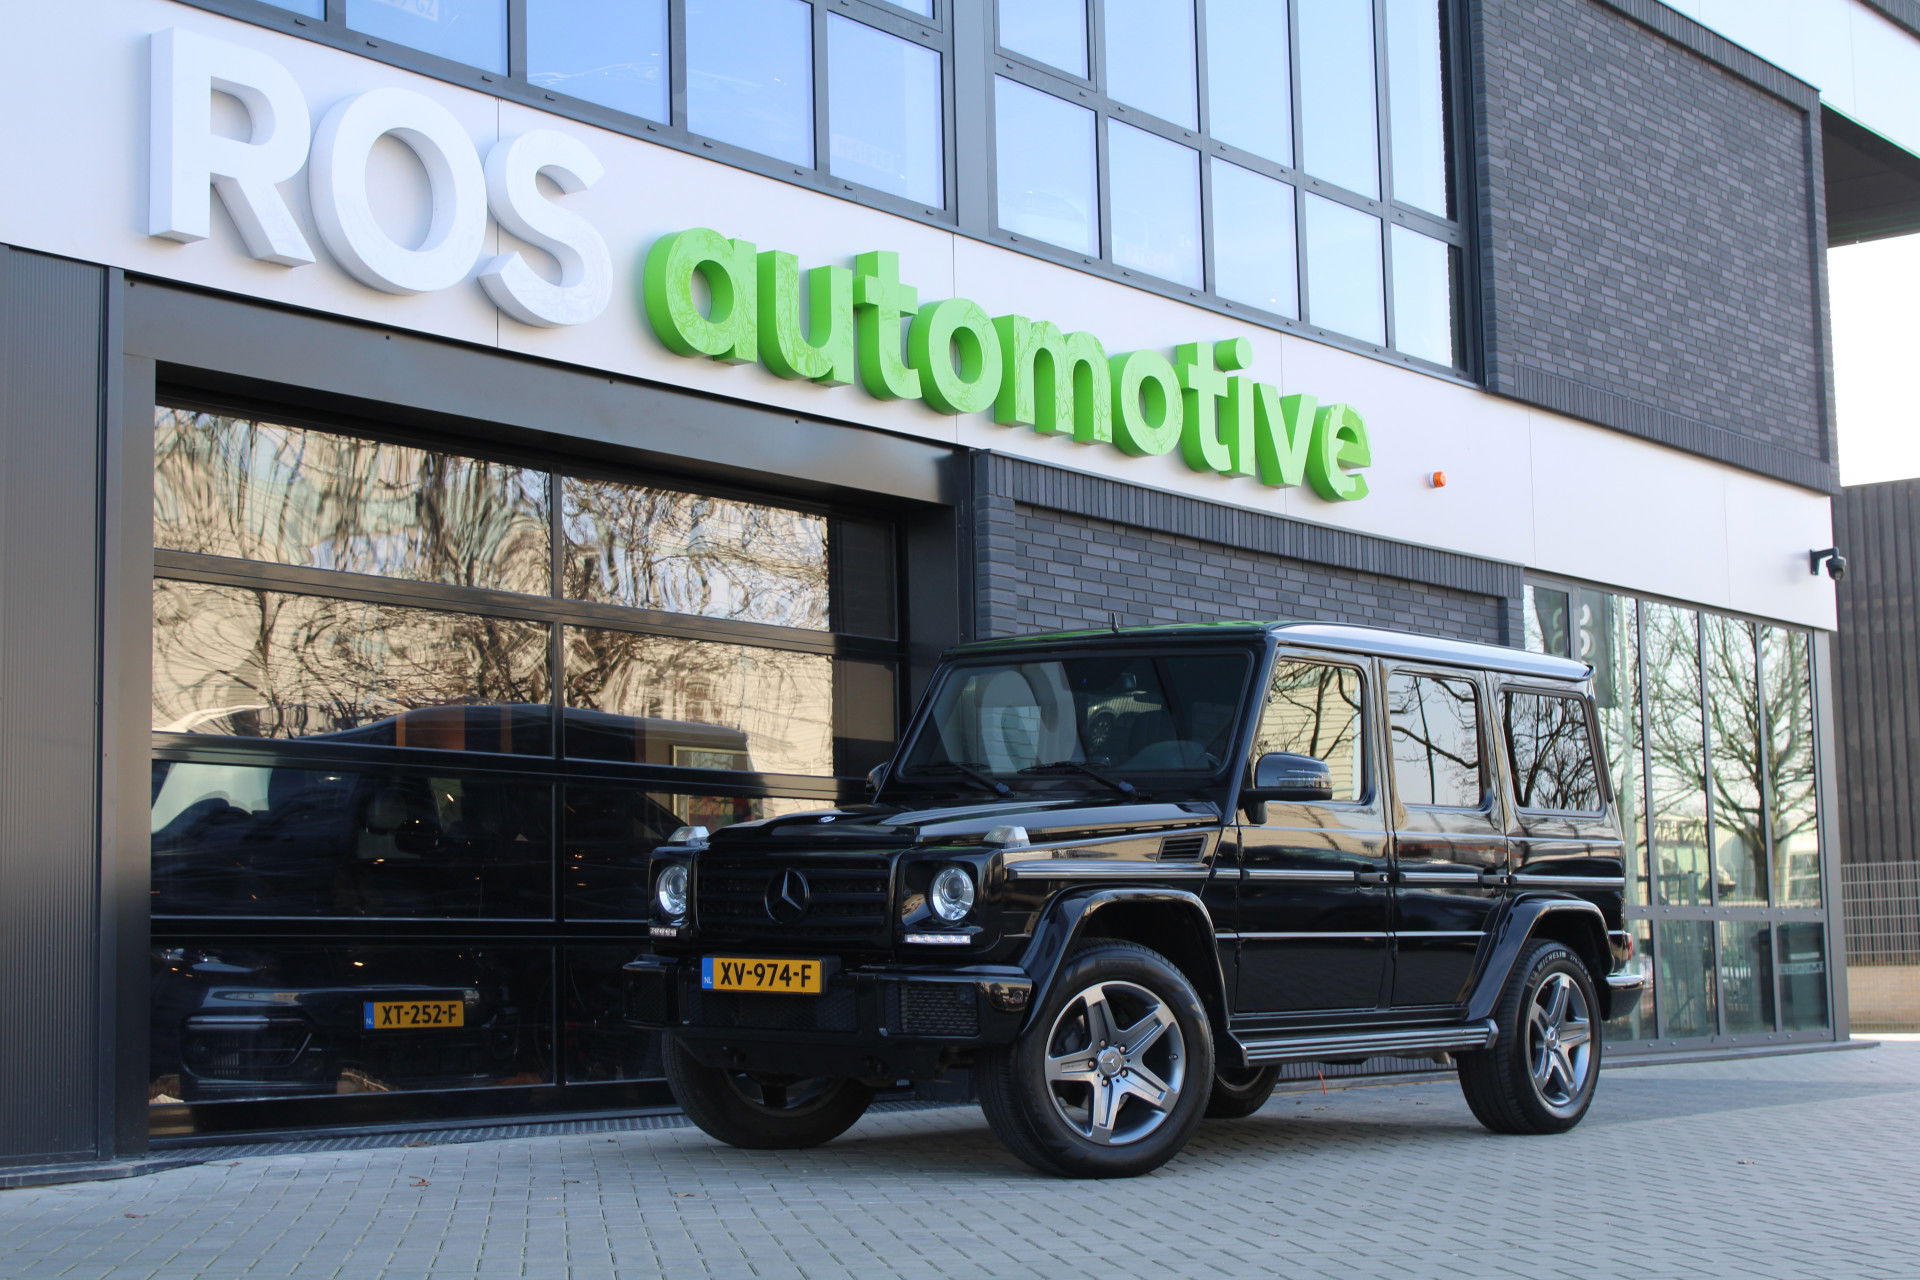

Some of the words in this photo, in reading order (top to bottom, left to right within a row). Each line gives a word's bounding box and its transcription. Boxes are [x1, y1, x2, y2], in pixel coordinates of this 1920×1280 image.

[149, 27, 613, 328] ROS
[643, 227, 1372, 502] automotive
[704, 976, 713, 984] NL
[720, 961, 812, 988] XV-974-F
[381, 1004, 457, 1025] XT-252-F
